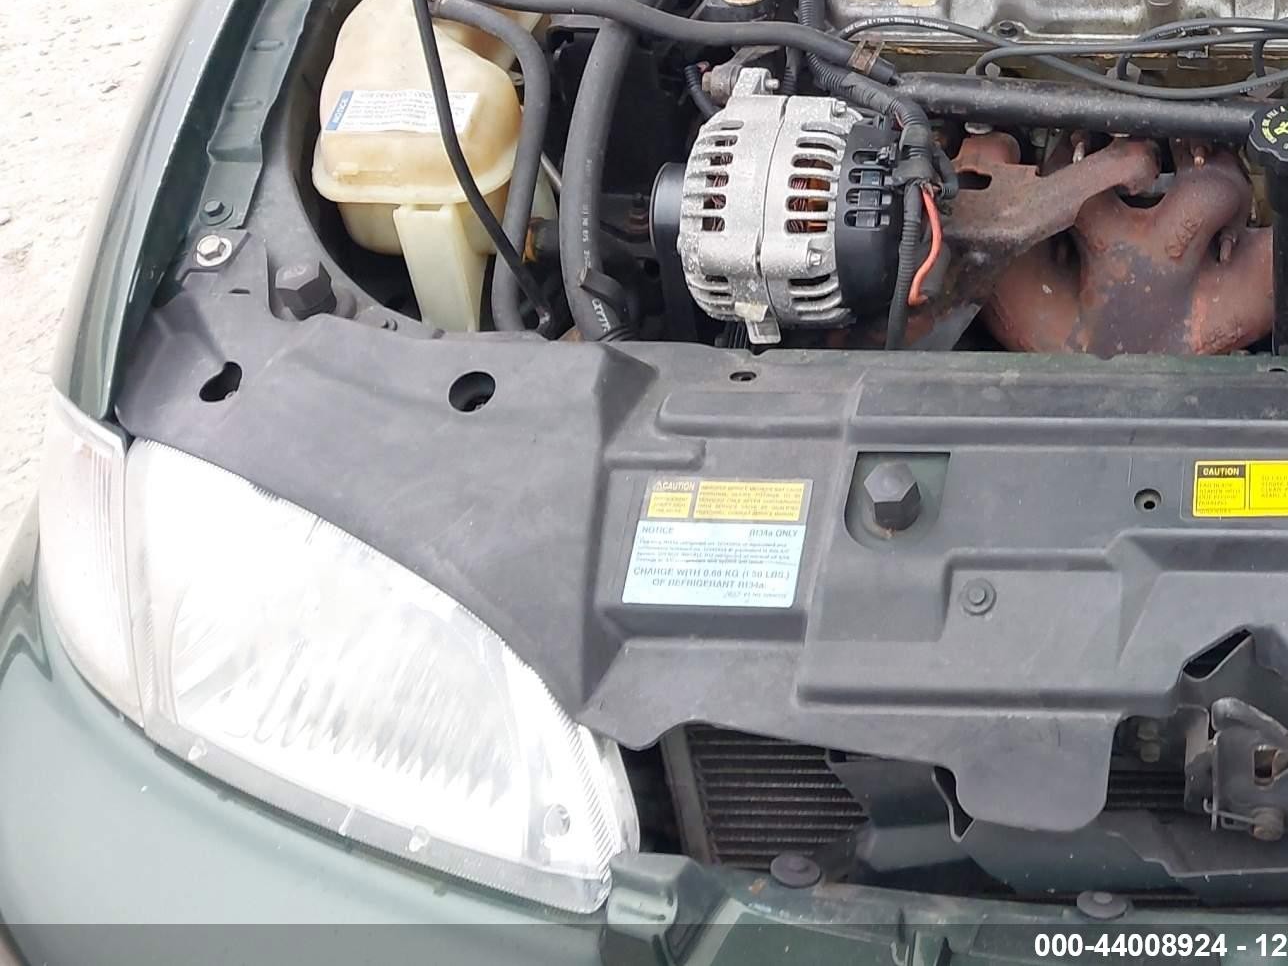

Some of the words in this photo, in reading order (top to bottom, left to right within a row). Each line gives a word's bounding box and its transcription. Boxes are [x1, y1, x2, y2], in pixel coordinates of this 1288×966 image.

[1202, 467, 1240, 476] CAUTION
[661, 481, 695, 491] CAUTION
[641, 526, 674, 534] NOTICE
[775, 529, 798, 537] ONLY
[633, 568, 674, 577] CHARGE
[676, 568, 701, 578] WITH
[725, 569, 739, 578] KG
[652, 579, 665, 587] OF
[667, 579, 735, 588] REFRIGERANT
